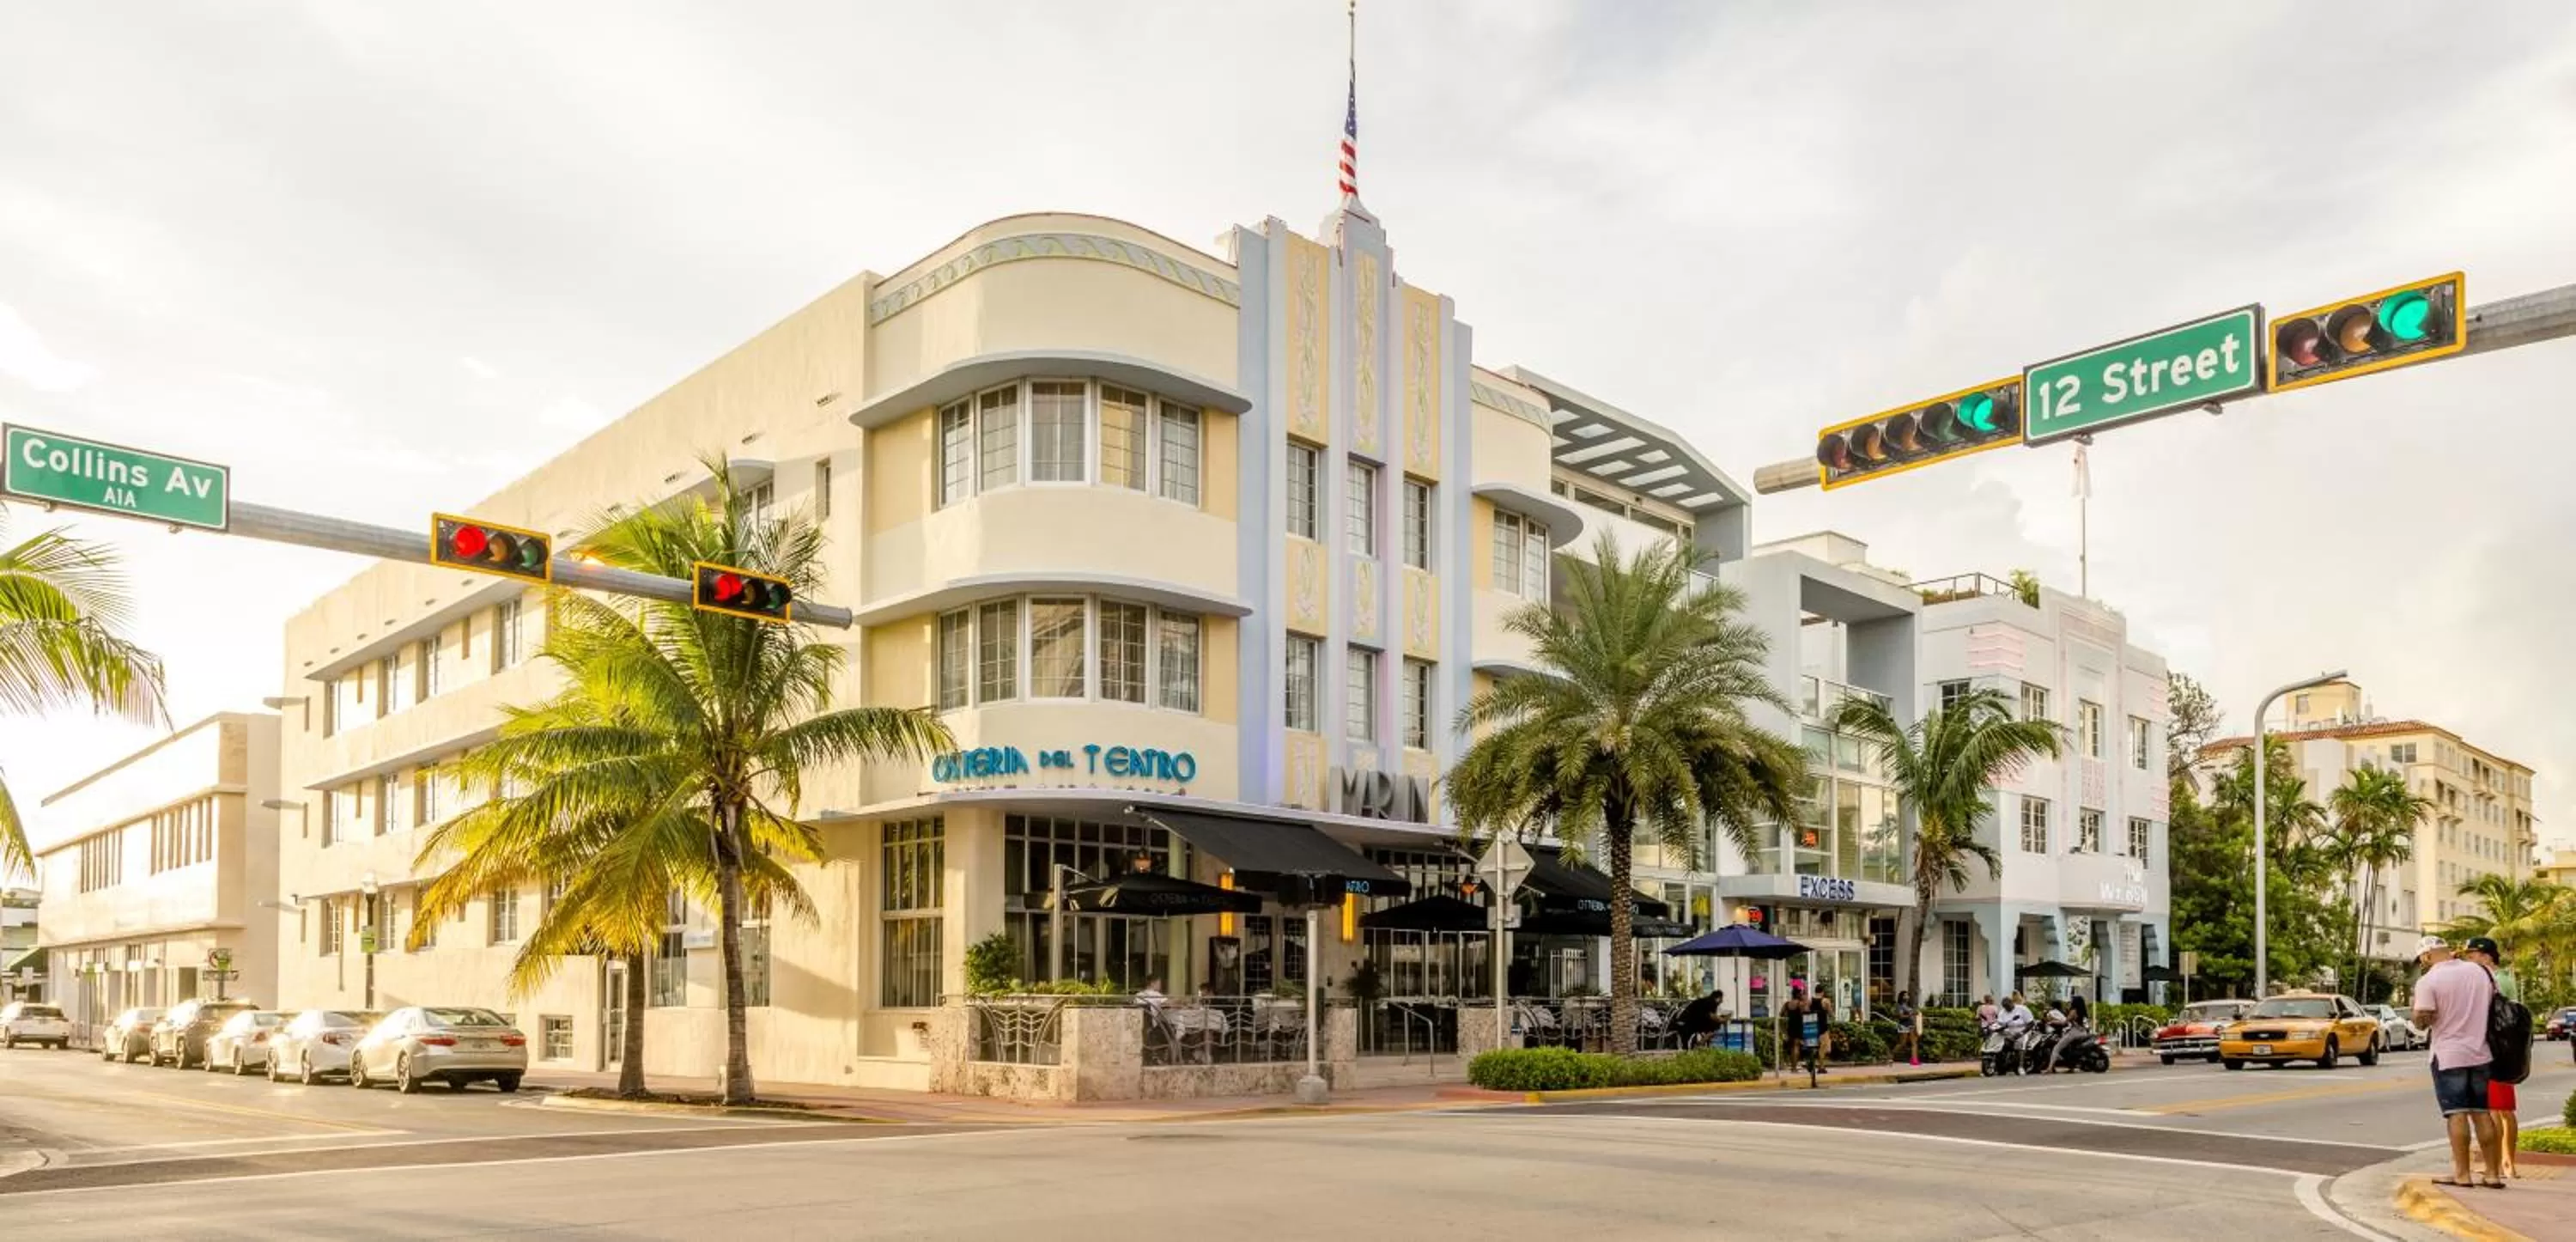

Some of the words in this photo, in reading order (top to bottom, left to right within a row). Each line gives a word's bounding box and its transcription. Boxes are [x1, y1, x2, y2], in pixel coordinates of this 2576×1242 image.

[2039, 374, 2081, 420] 12
[2101, 332, 2240, 404] Street
[22, 438, 149, 487] Collins
[165, 466, 213, 499] Av
[102, 486, 137, 508] A1A
[1039, 750, 1074, 770] DEL
[1800, 875, 1855, 901] EXCESS
